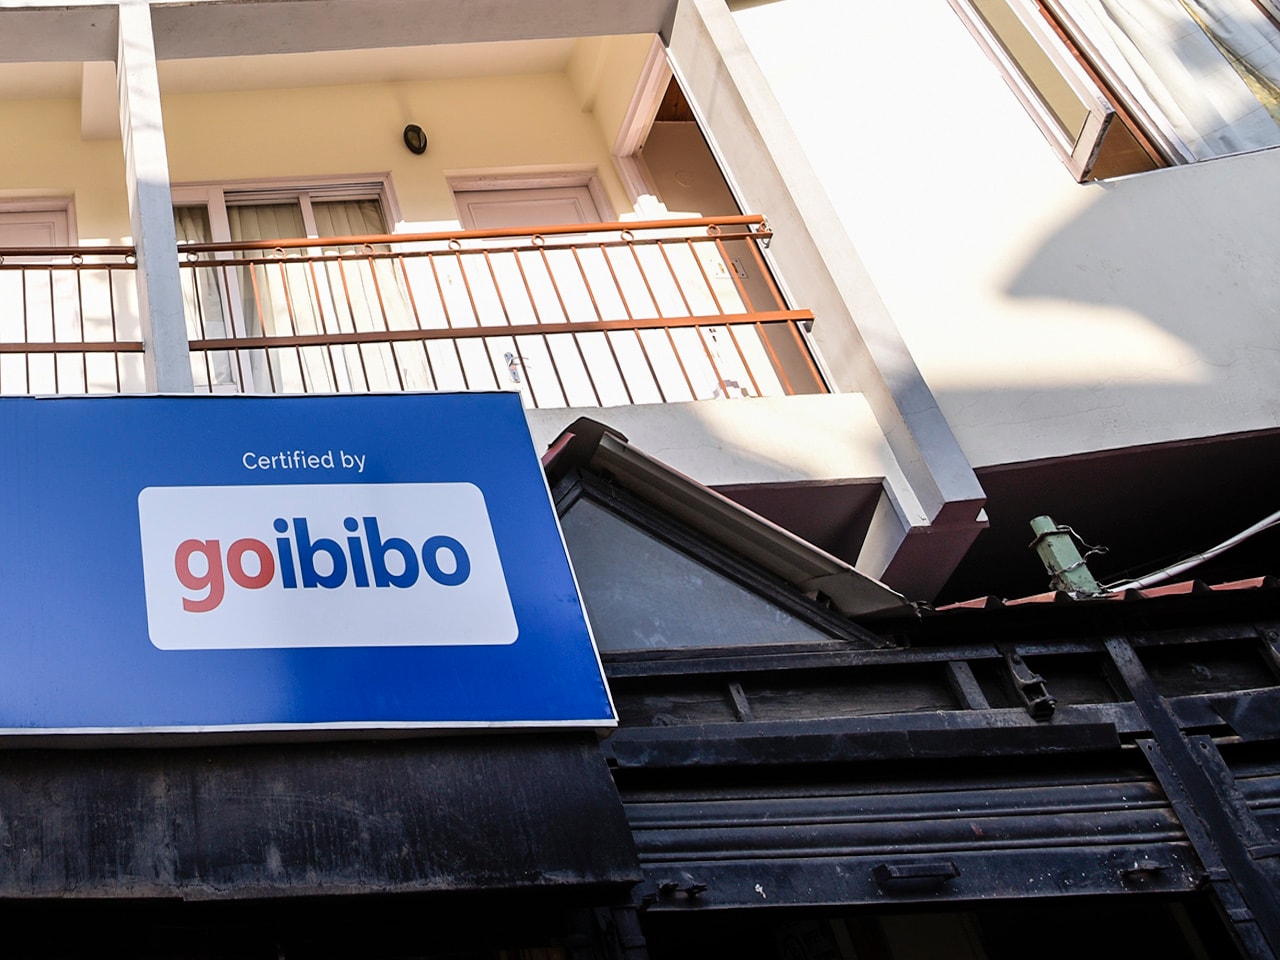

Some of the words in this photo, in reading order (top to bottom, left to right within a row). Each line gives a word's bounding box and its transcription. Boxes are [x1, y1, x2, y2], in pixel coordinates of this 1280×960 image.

[242, 450, 335, 470] Certified
[340, 450, 366, 473] by
[173, 516, 472, 614] goibibo
